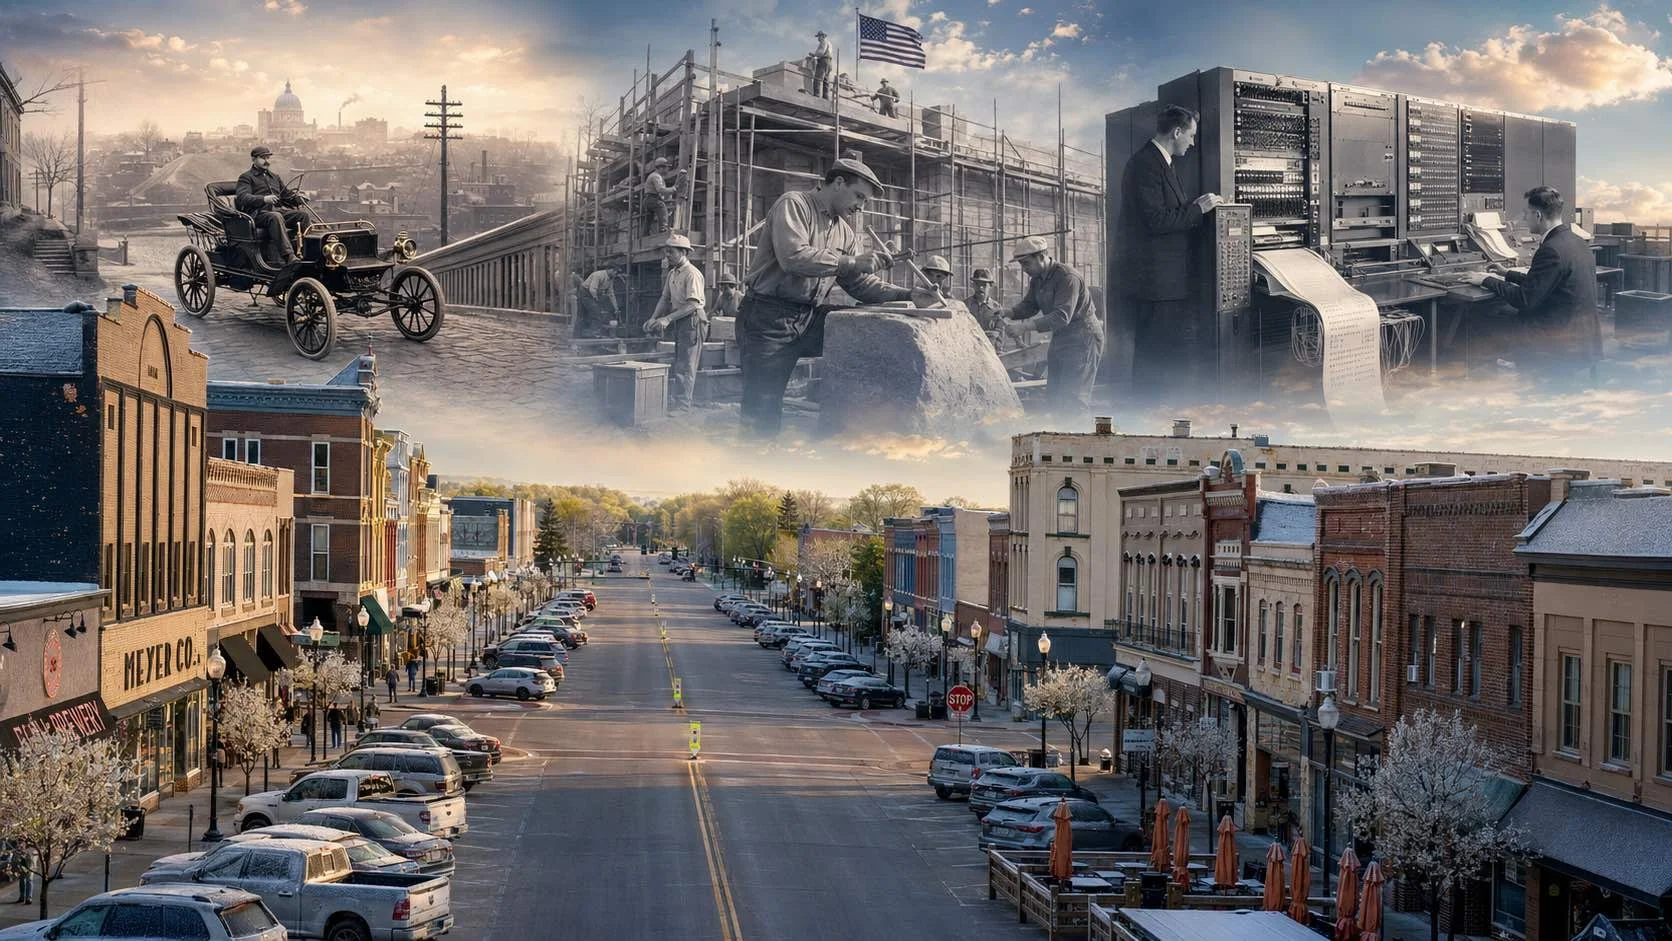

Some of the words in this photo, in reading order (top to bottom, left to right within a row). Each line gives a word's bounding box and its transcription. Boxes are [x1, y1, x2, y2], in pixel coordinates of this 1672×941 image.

[124, 642, 171, 691] MEYER
[176, 636, 197, 673] CO.
[949, 694, 973, 705] STOP
